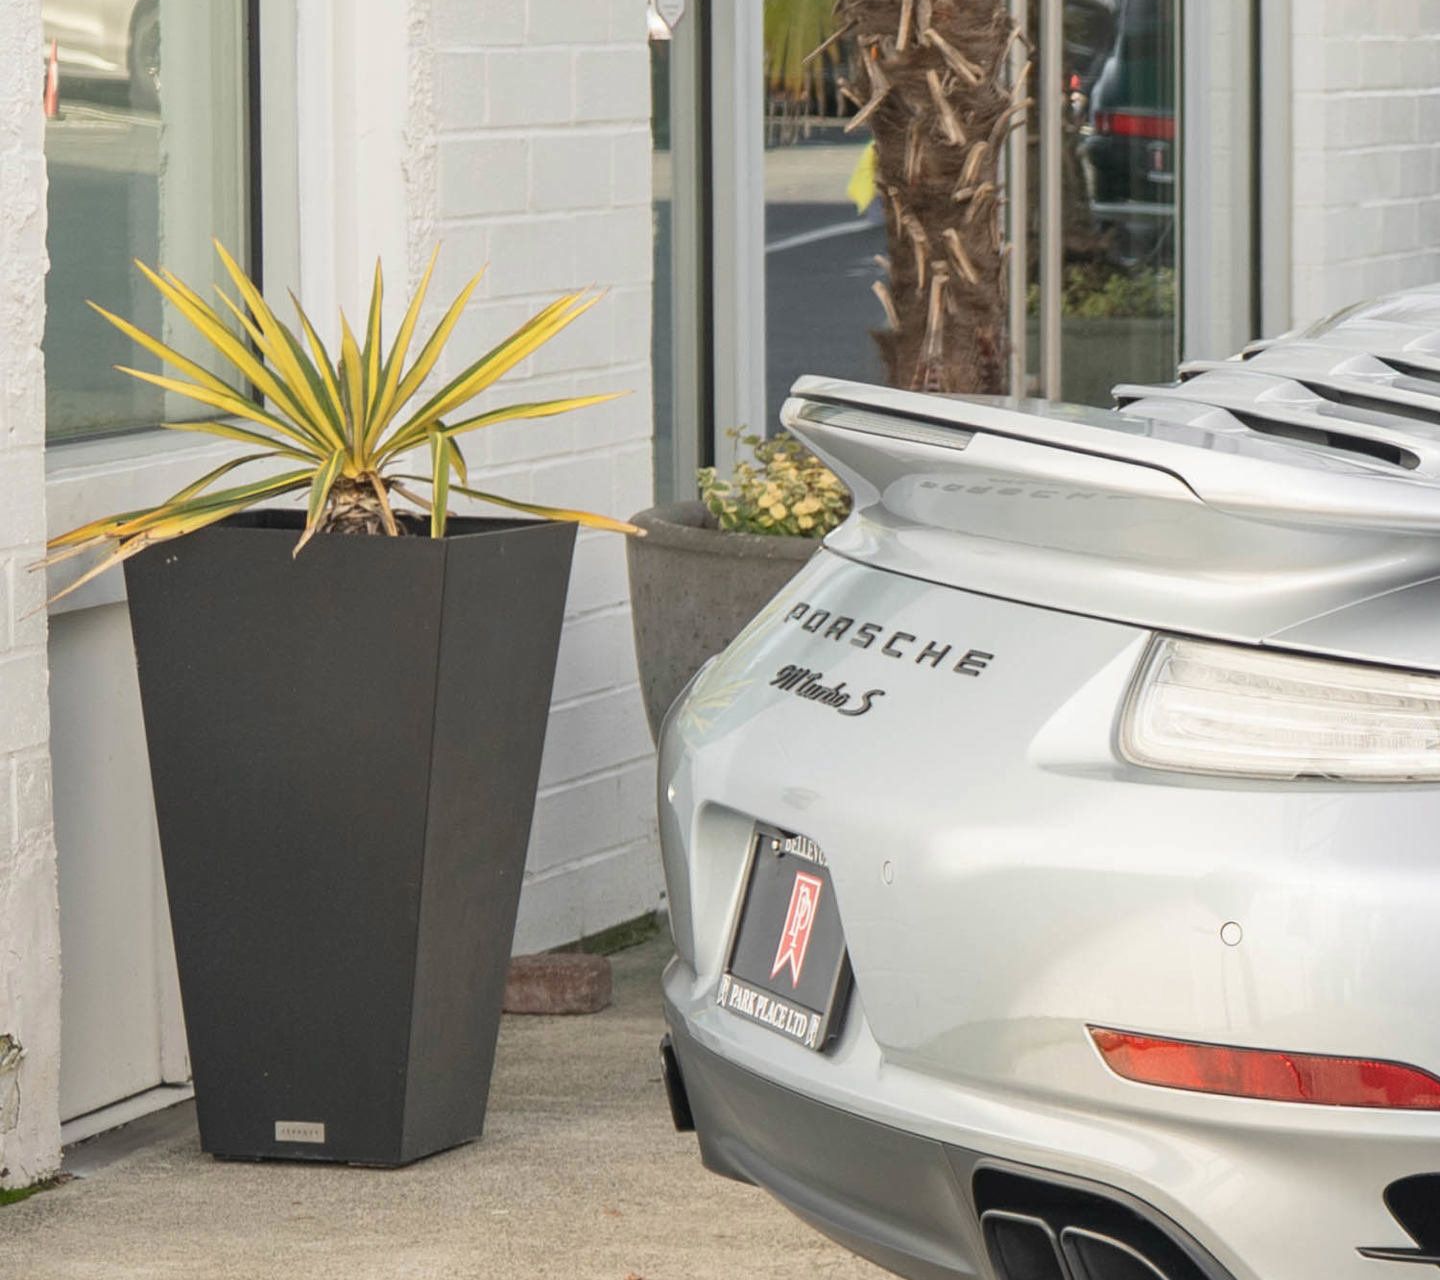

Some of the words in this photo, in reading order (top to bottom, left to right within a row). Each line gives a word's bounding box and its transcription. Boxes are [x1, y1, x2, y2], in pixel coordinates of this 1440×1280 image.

[784, 602, 994, 677] PORSCHE
[837, 689, 886, 716] S
[729, 984, 758, 1016] PARK
[754, 994, 789, 1030] PLACE
[784, 1009, 808, 1038] LTD
